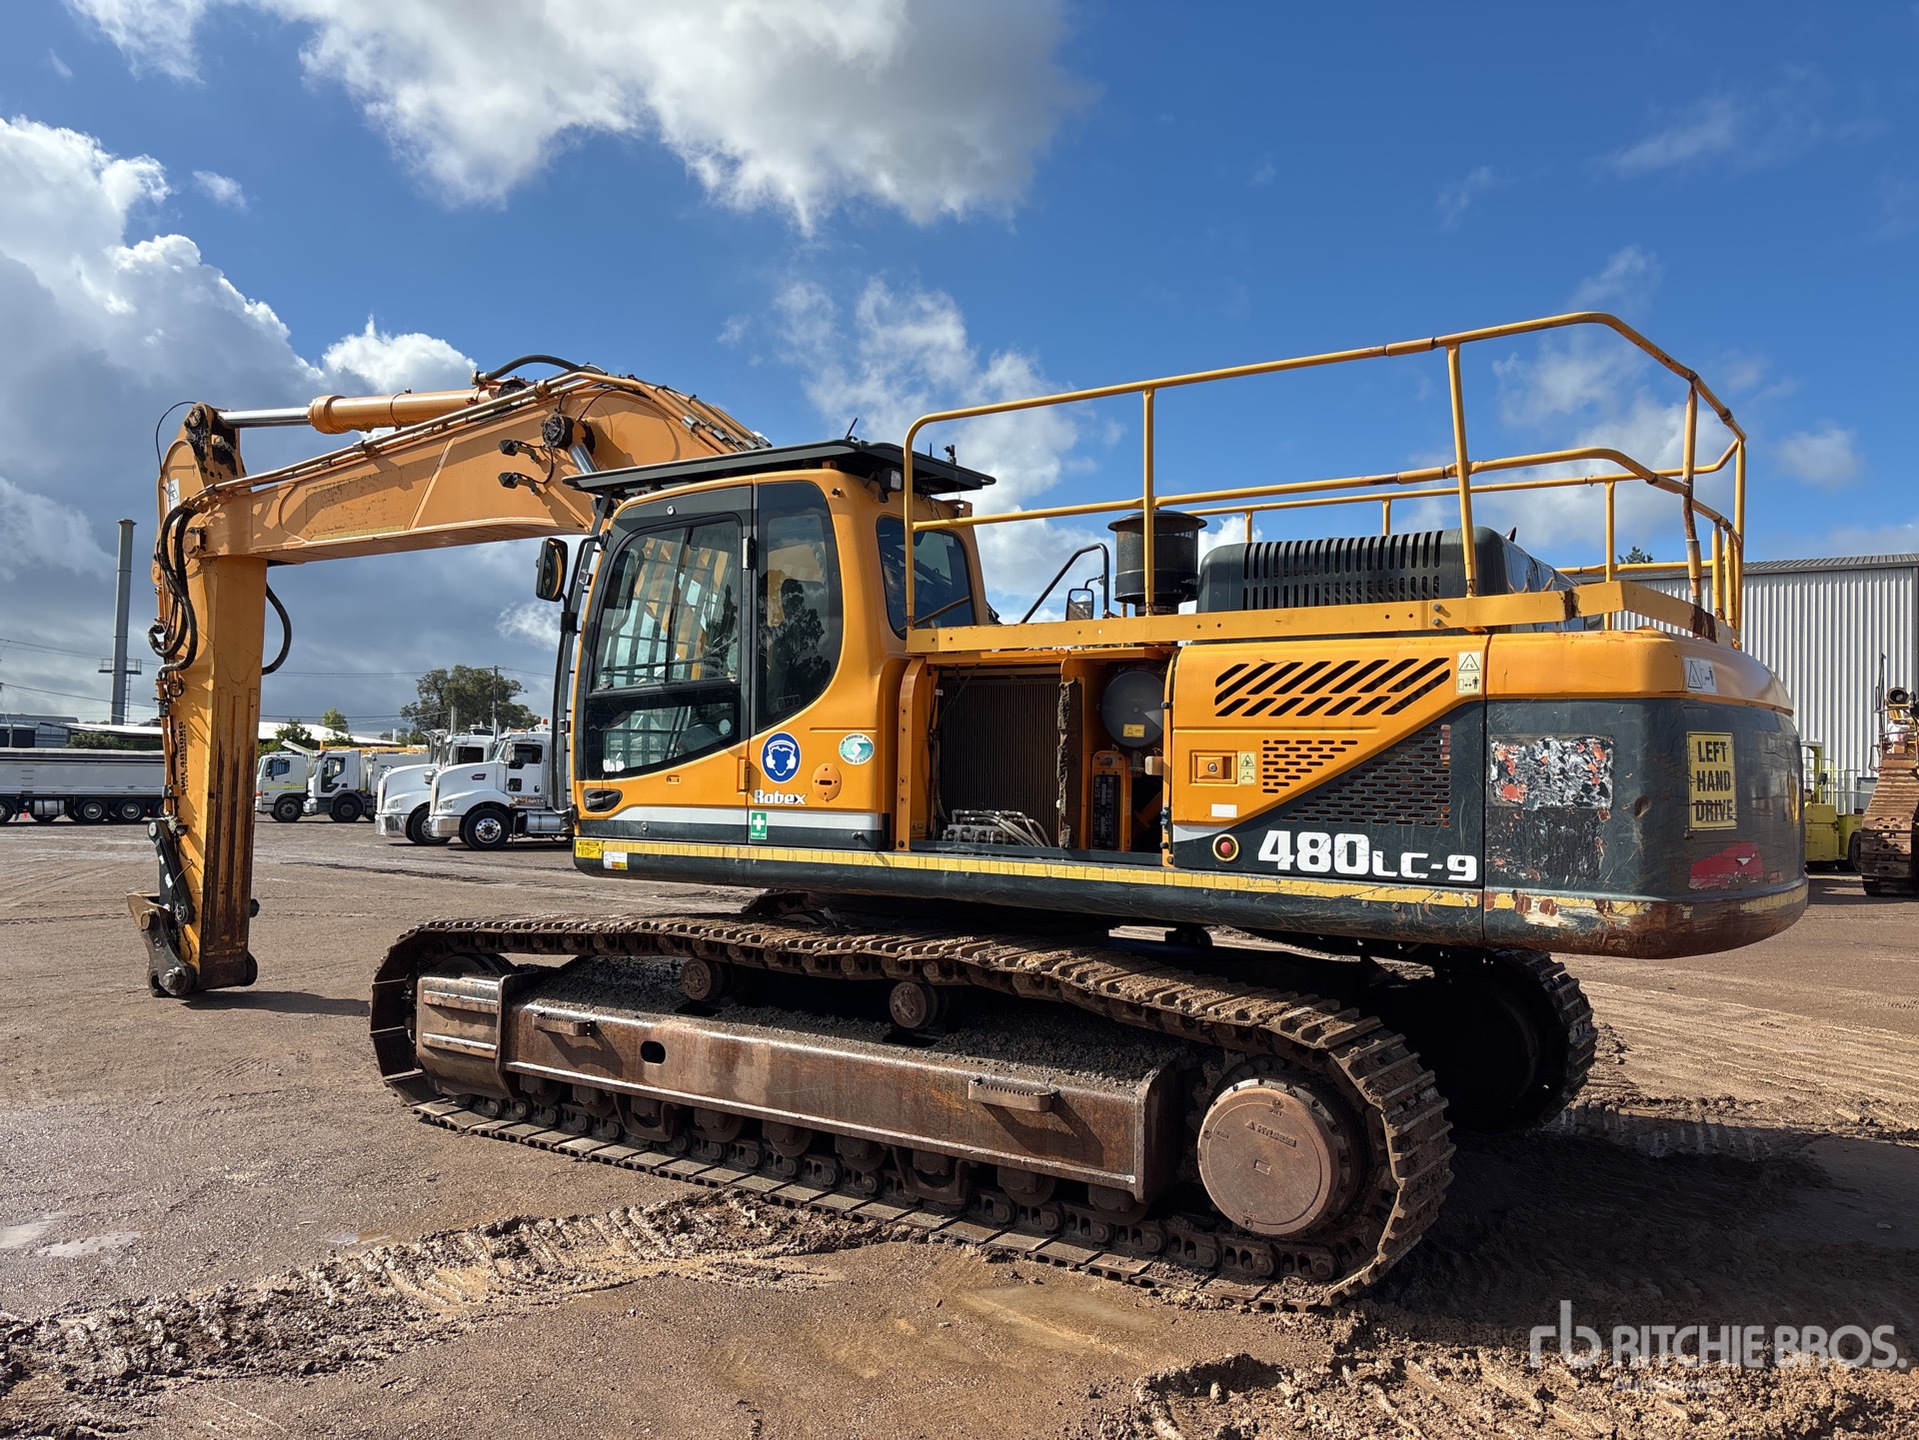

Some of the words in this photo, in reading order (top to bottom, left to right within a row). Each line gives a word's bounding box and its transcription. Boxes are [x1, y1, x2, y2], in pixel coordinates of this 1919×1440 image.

[1697, 741, 1727, 763] LEFT
[1696, 770, 1731, 792] HAND
[1695, 799, 1734, 822] DRIVE
